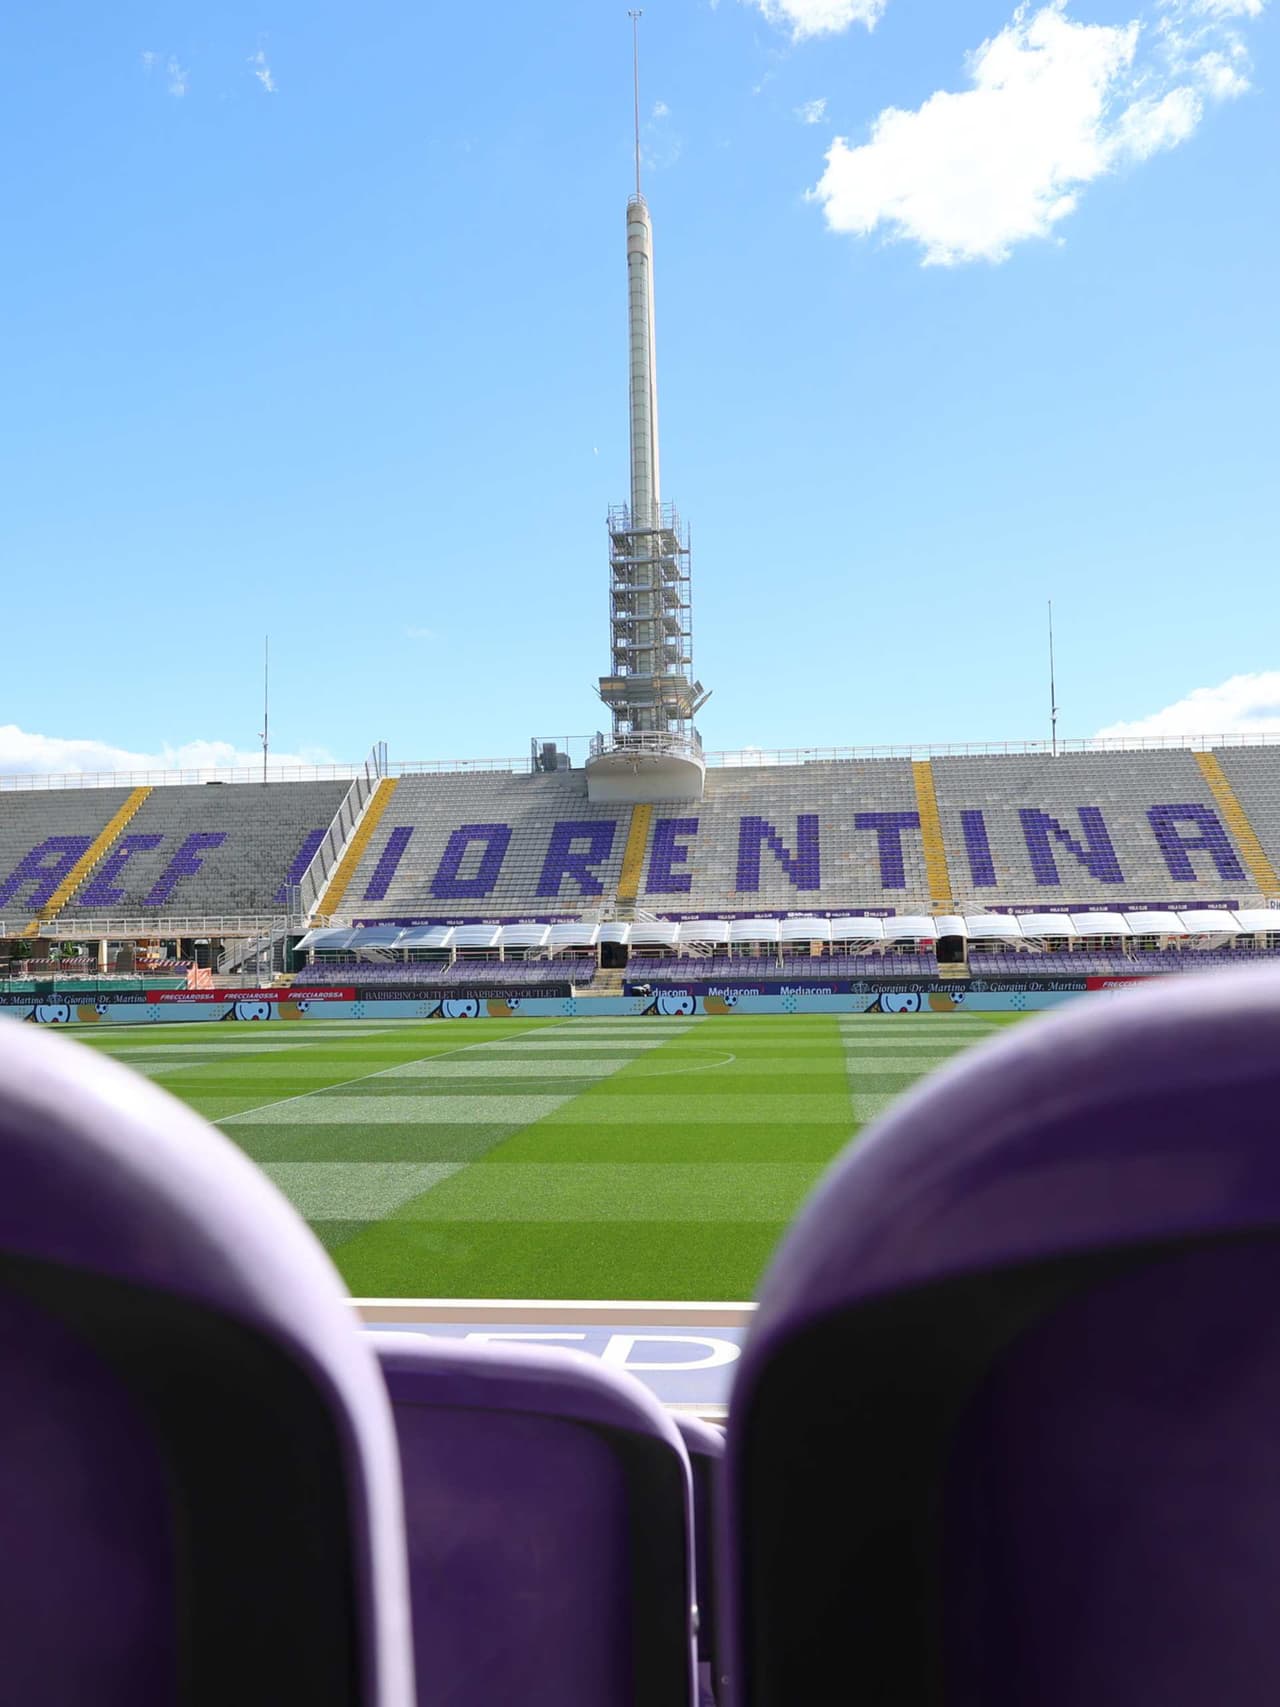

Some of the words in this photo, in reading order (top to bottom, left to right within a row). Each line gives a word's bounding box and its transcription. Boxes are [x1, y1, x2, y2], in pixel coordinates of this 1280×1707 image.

[0, 832, 228, 907] ACF
[780, 985, 832, 995] Mediacom
[909, 983, 925, 993] Dr.
[928, 983, 966, 992] Martino
[1030, 981, 1045, 991] Dr.
[1048, 980, 1087, 991] Martino
[708, 986, 759, 996] Mediacom
[115, 993, 147, 1003] Martino
